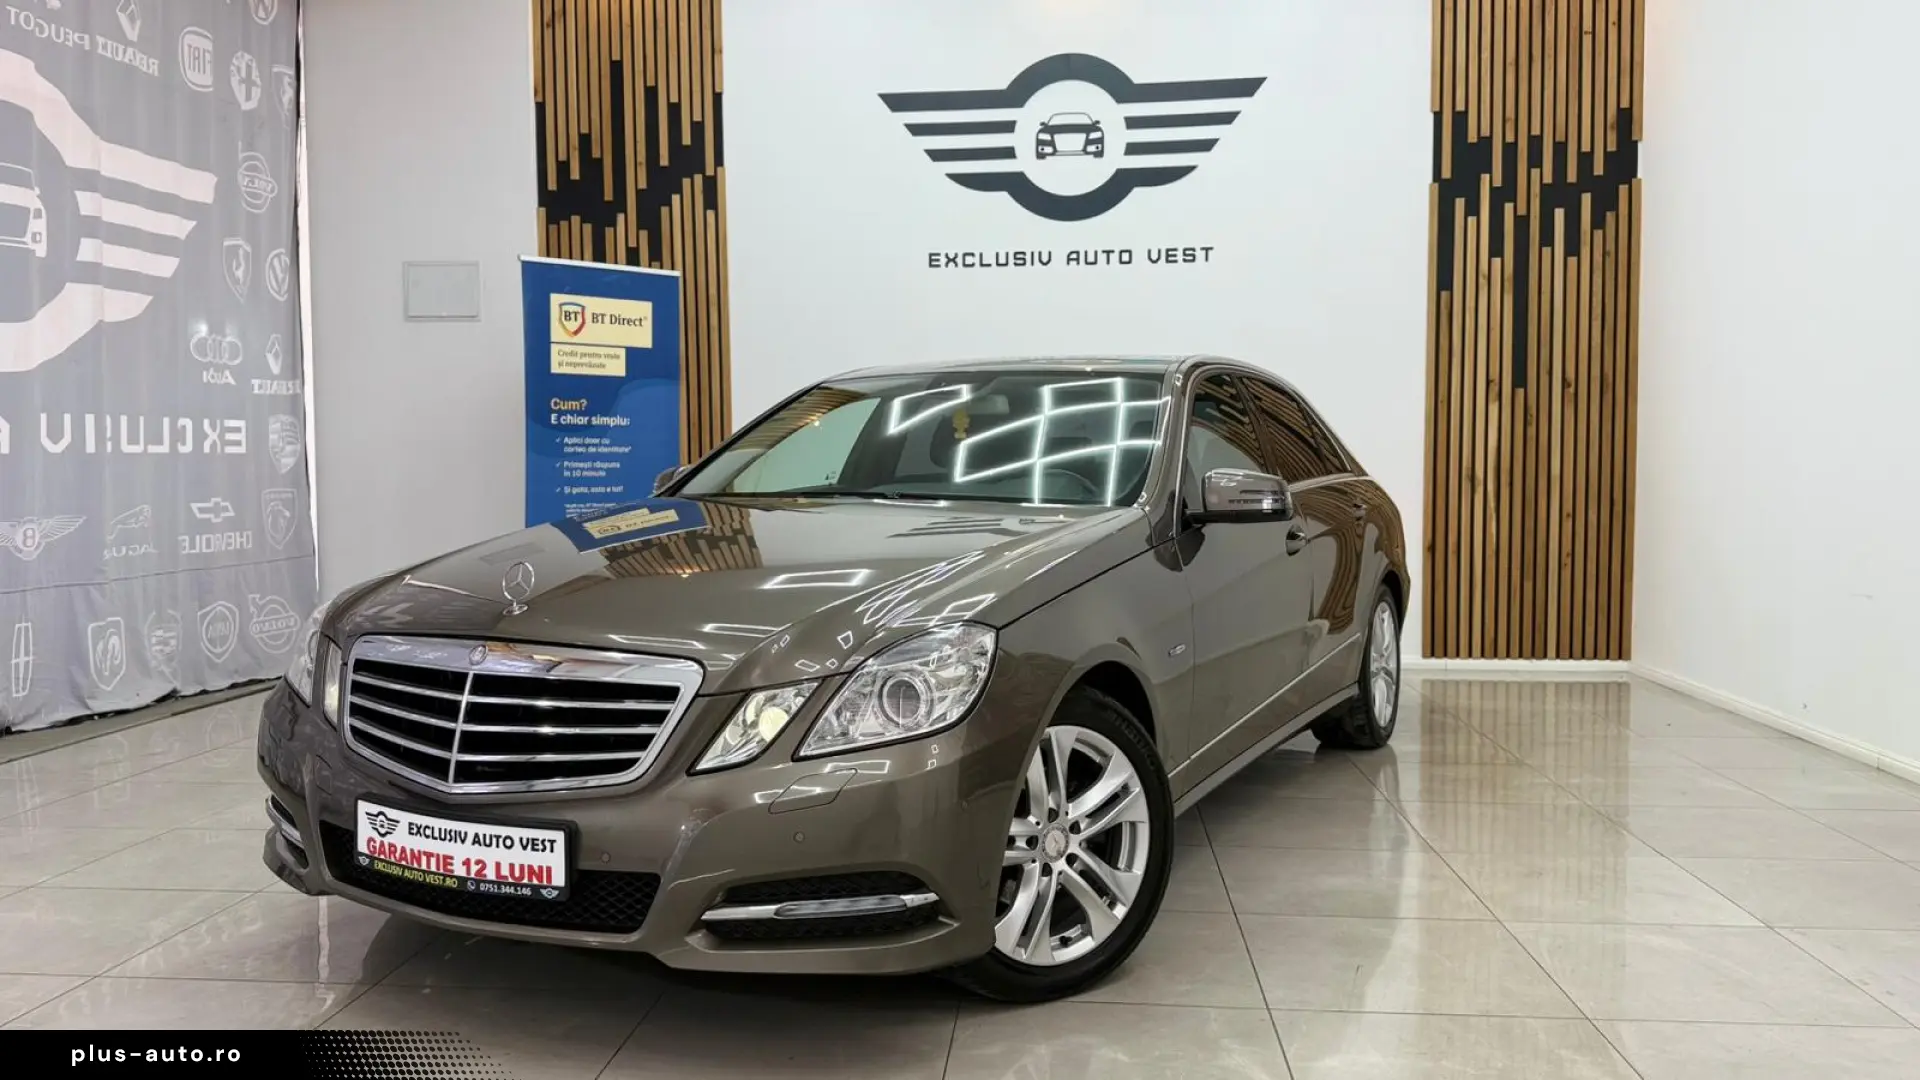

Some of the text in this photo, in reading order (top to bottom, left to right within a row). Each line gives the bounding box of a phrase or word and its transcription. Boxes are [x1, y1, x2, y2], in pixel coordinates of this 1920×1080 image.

[928, 246, 1215, 268] EXCLUSIV AUTO VEST
[563, 310, 580, 322] BT
[591, 312, 644, 327] BT Direct
[557, 349, 578, 358] Credit
[551, 397, 587, 411] Cum?
[551, 414, 630, 427] E chiar simplu:
[408, 821, 557, 853] EXCLUSIV AUTO VEST
[366, 836, 553, 885] GARANTIE 12 LUNI
[374, 861, 458, 888] EXCLUSIV AUTO VEST.RO
[480, 883, 532, 896] 0751.344.146
